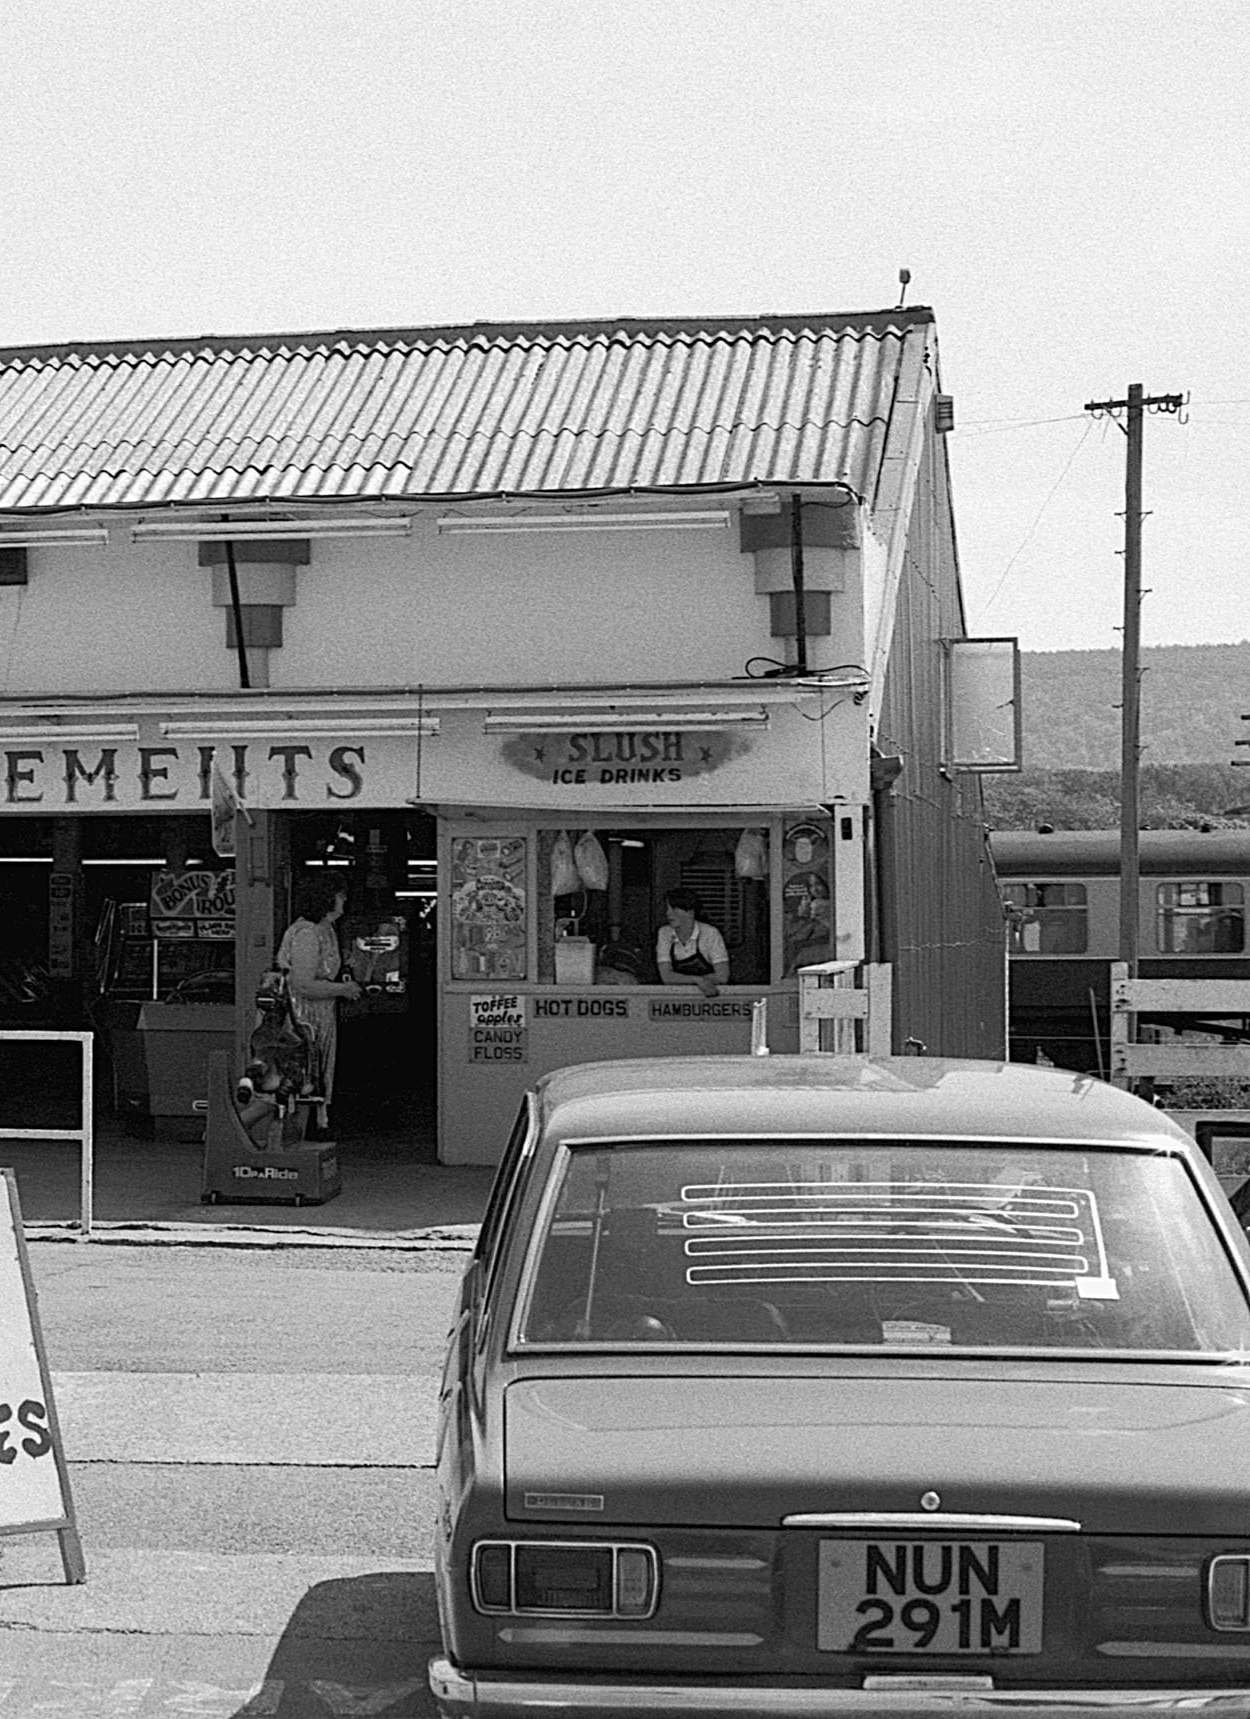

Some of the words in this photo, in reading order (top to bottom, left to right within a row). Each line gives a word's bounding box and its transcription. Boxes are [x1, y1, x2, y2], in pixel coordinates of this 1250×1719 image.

[568, 732, 684, 763] SLUSH
[552, 769, 587, 785] ICE
[599, 767, 682, 784] DRINKS
[160, 874, 210, 911] BONUS
[472, 996, 518, 1014] TOFFEE
[535, 999, 572, 1016] HOT
[578, 1000, 628, 1016] DOGS
[652, 1003, 750, 1017] HAMBURGERS
[474, 1030, 523, 1044] CANDY
[474, 1046, 523, 1060] FLOSS
[865, 1543, 999, 1597] NUN
[853, 1597, 1021, 1650] 291M
